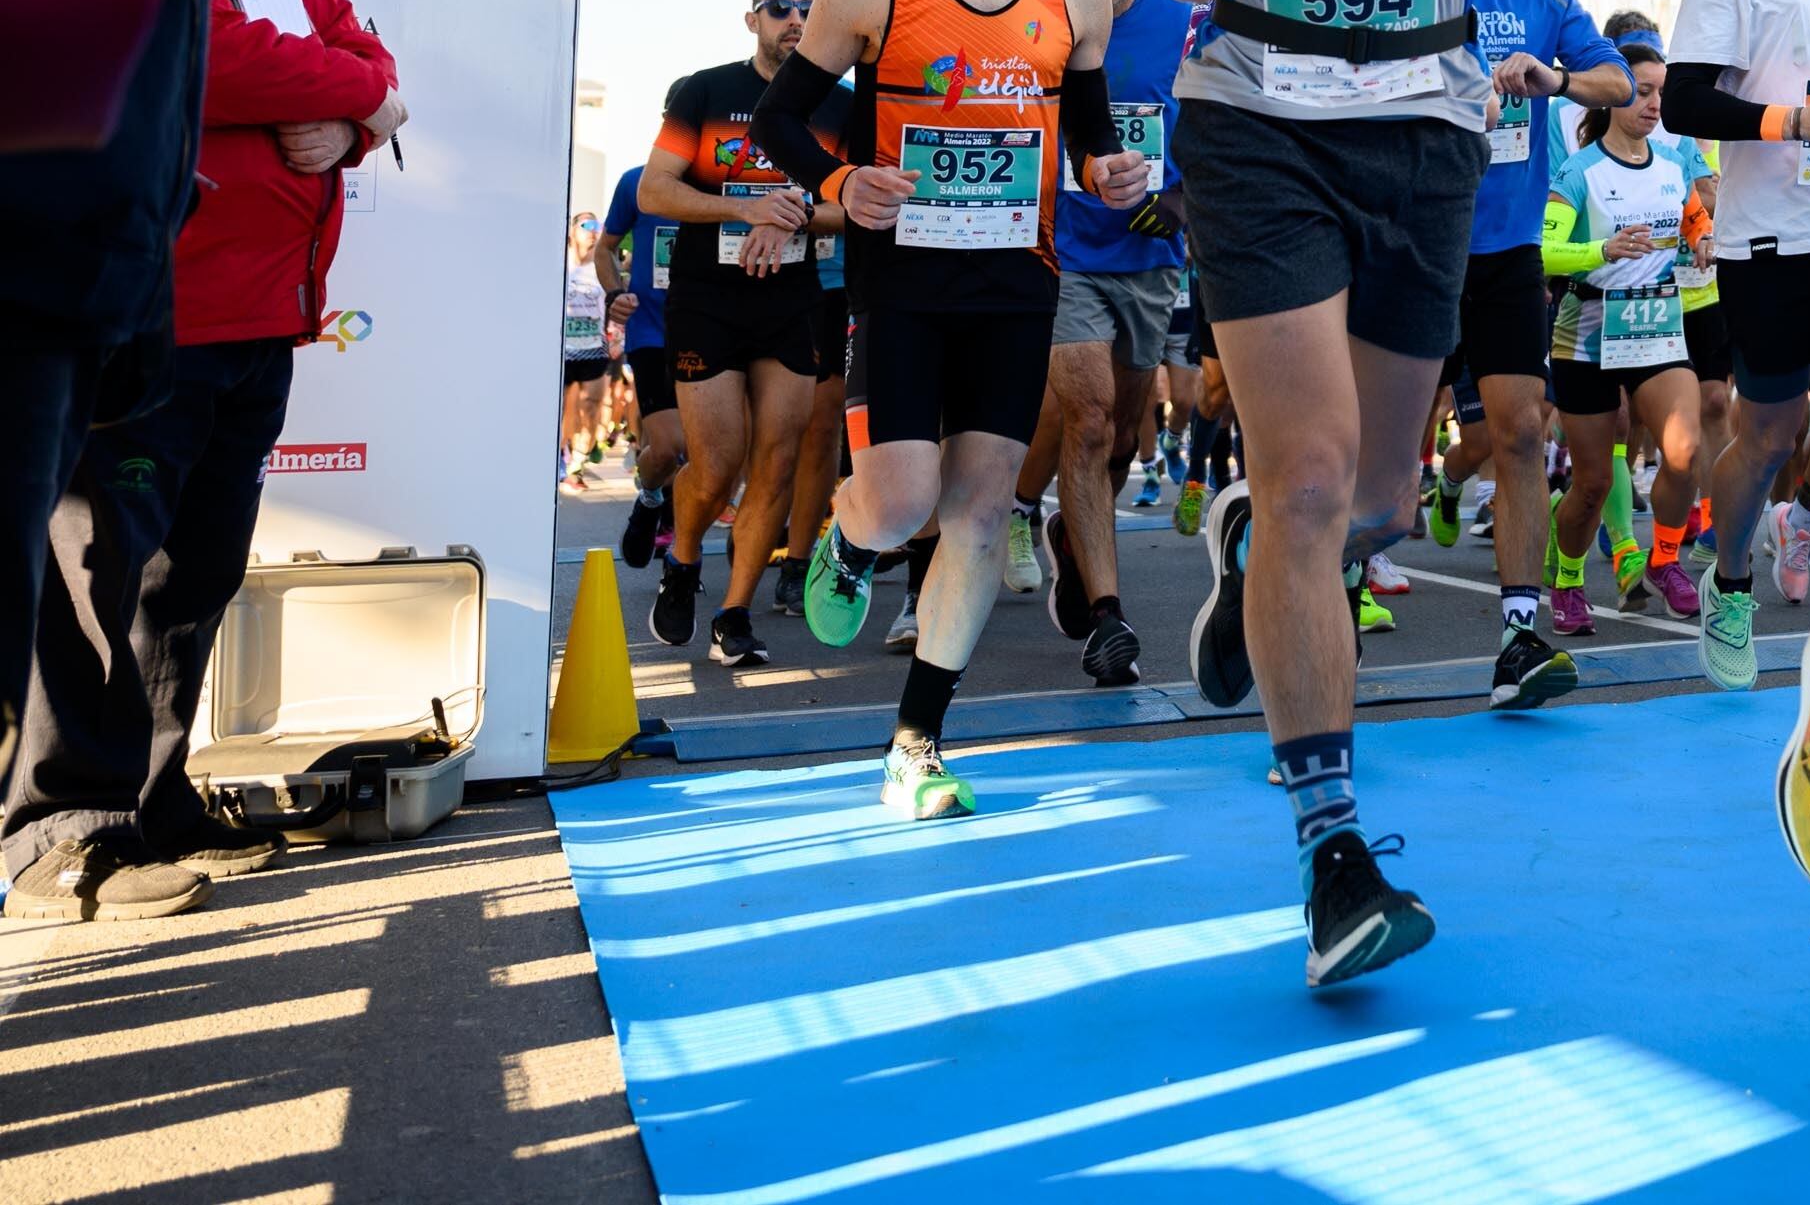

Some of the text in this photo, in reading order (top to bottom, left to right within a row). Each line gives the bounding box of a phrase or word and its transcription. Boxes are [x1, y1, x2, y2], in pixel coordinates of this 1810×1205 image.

[981, 54, 1032, 71] triatlón
[944, 137, 972, 145] Almería
[932, 148, 1015, 184] 952
[1654, 218, 1679, 228] 2022
[1620, 298, 1669, 324] 412
